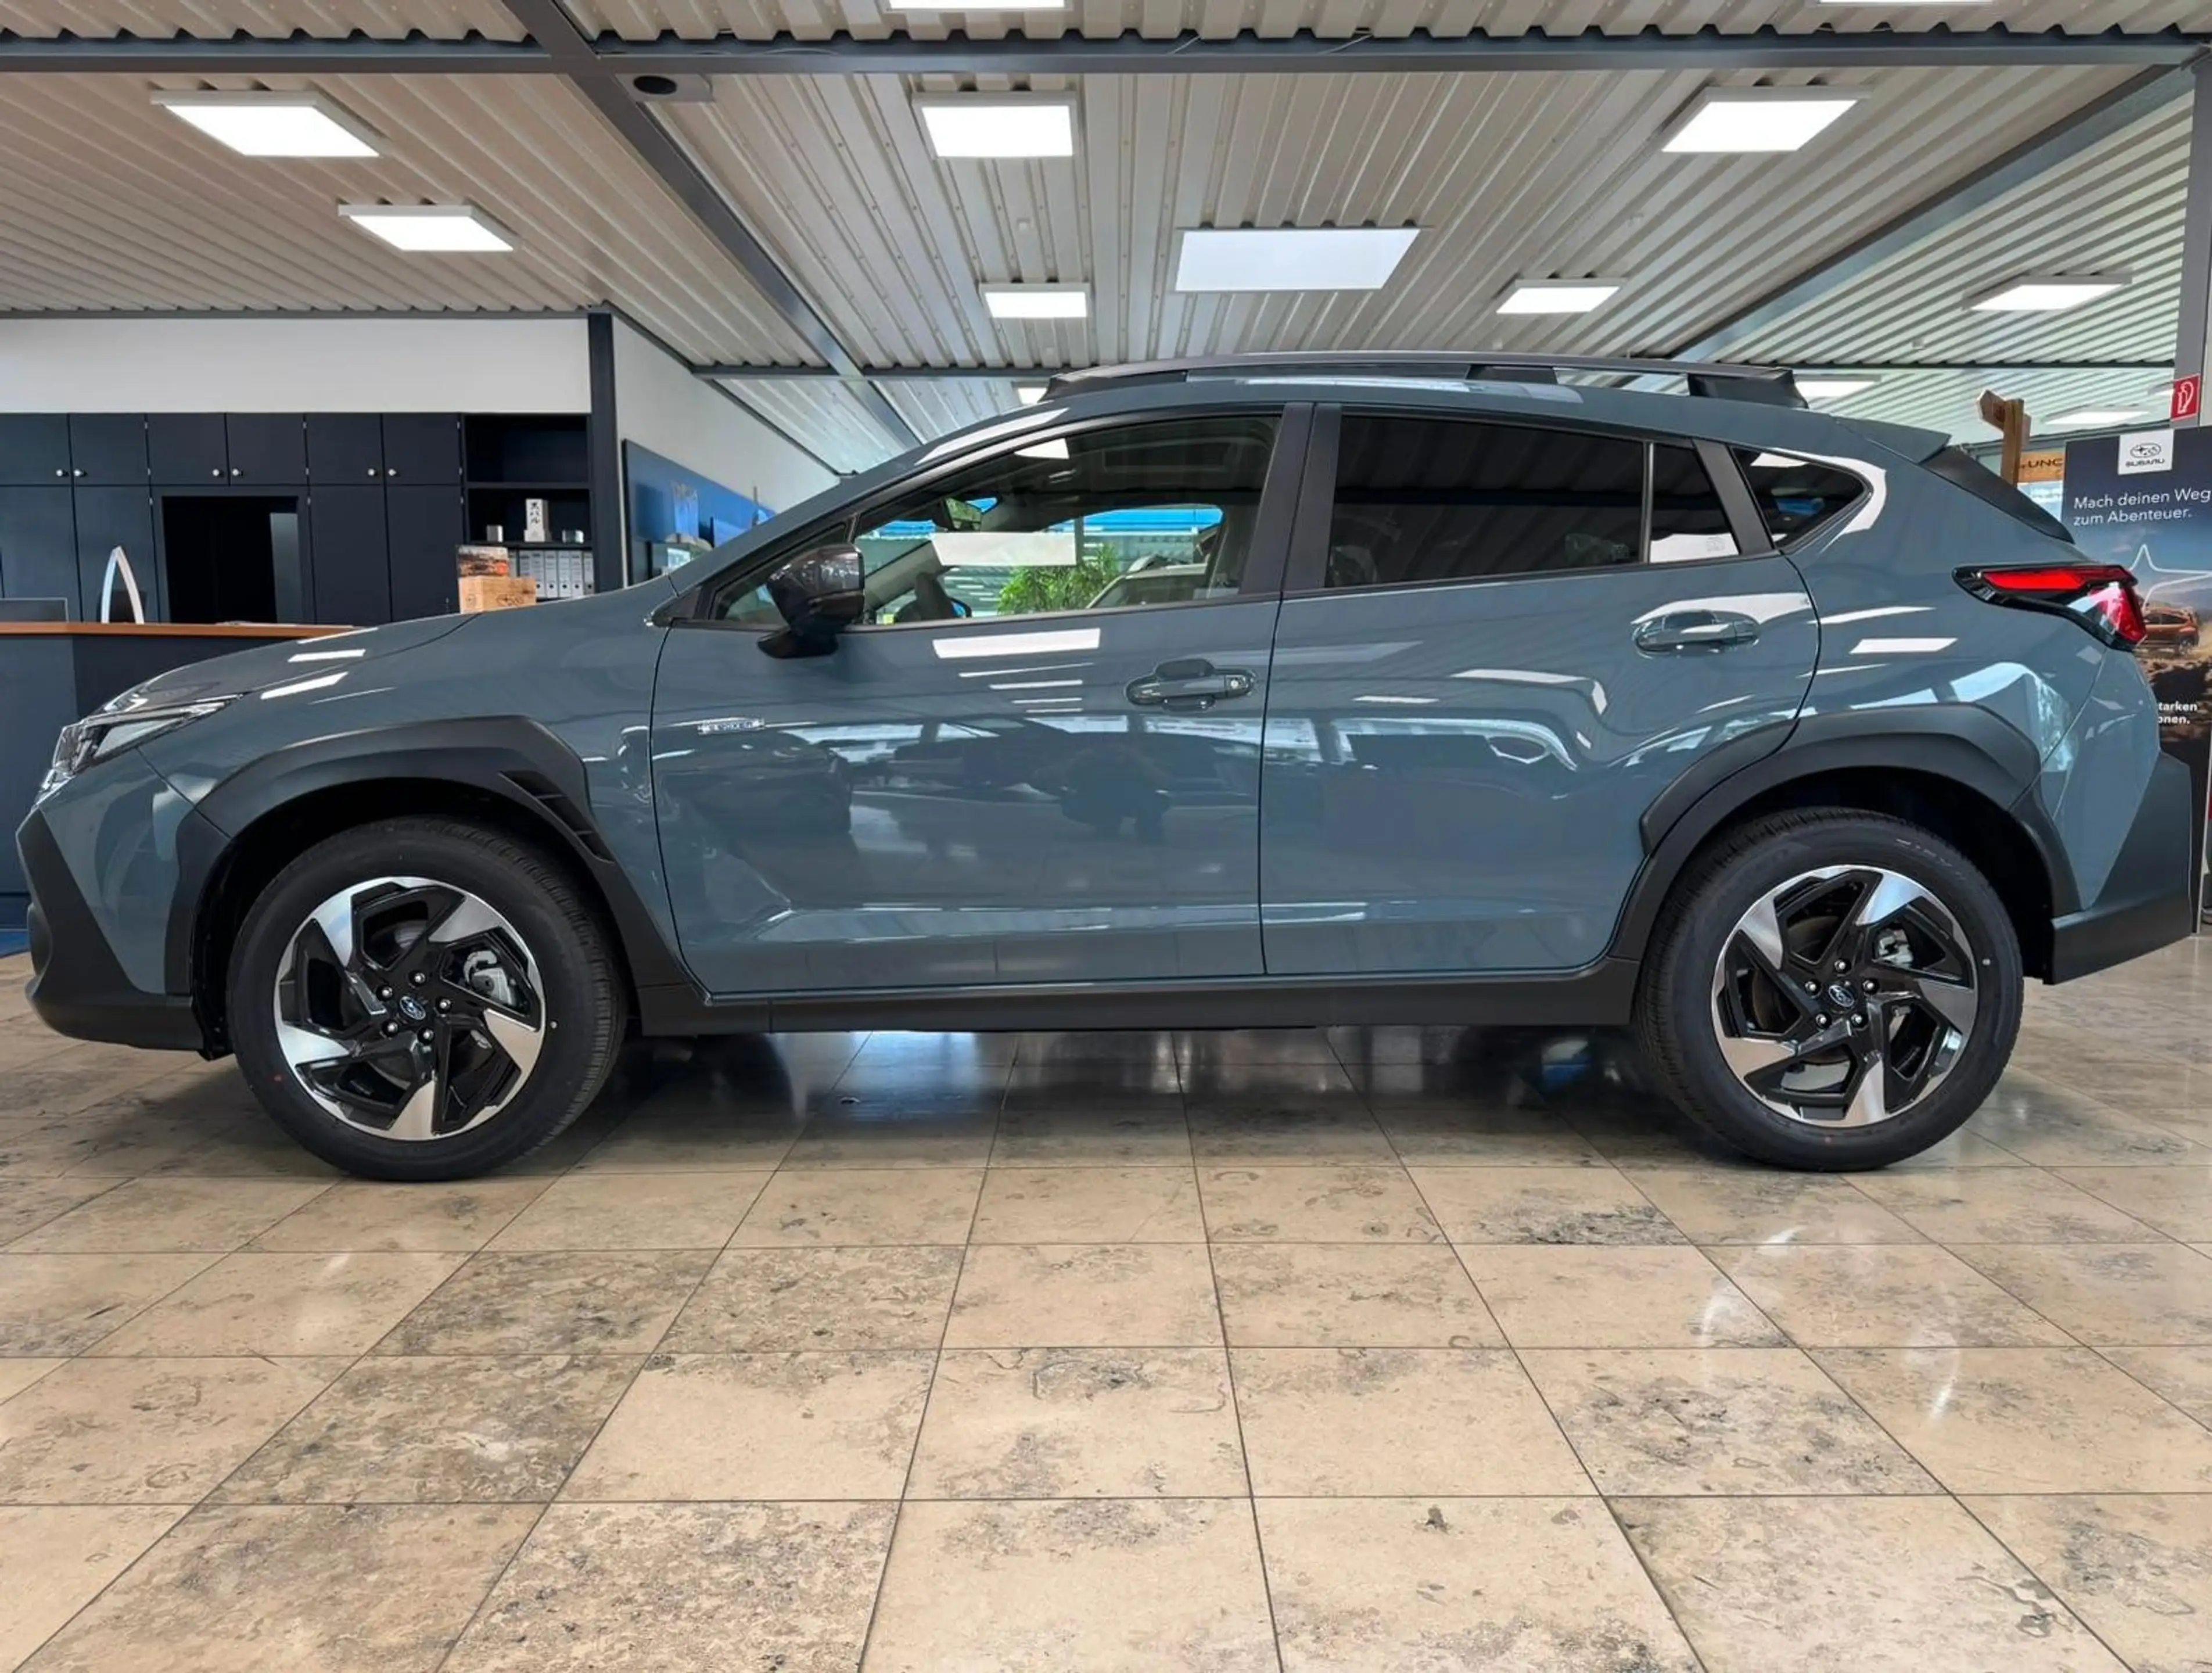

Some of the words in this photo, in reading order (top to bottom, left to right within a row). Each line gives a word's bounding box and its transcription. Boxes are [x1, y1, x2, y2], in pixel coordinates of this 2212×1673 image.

[2125, 458, 2165, 467] SUBARU
[2073, 494, 2113, 509] Mach
[2117, 492, 2170, 506] deinen
[2174, 487, 2211, 503] Weg
[2073, 515, 2104, 526] zum
[2107, 508, 2193, 523] Abenteuer.
[2158, 701, 2198, 712] tarken
[2158, 716, 2191, 724] onen.
